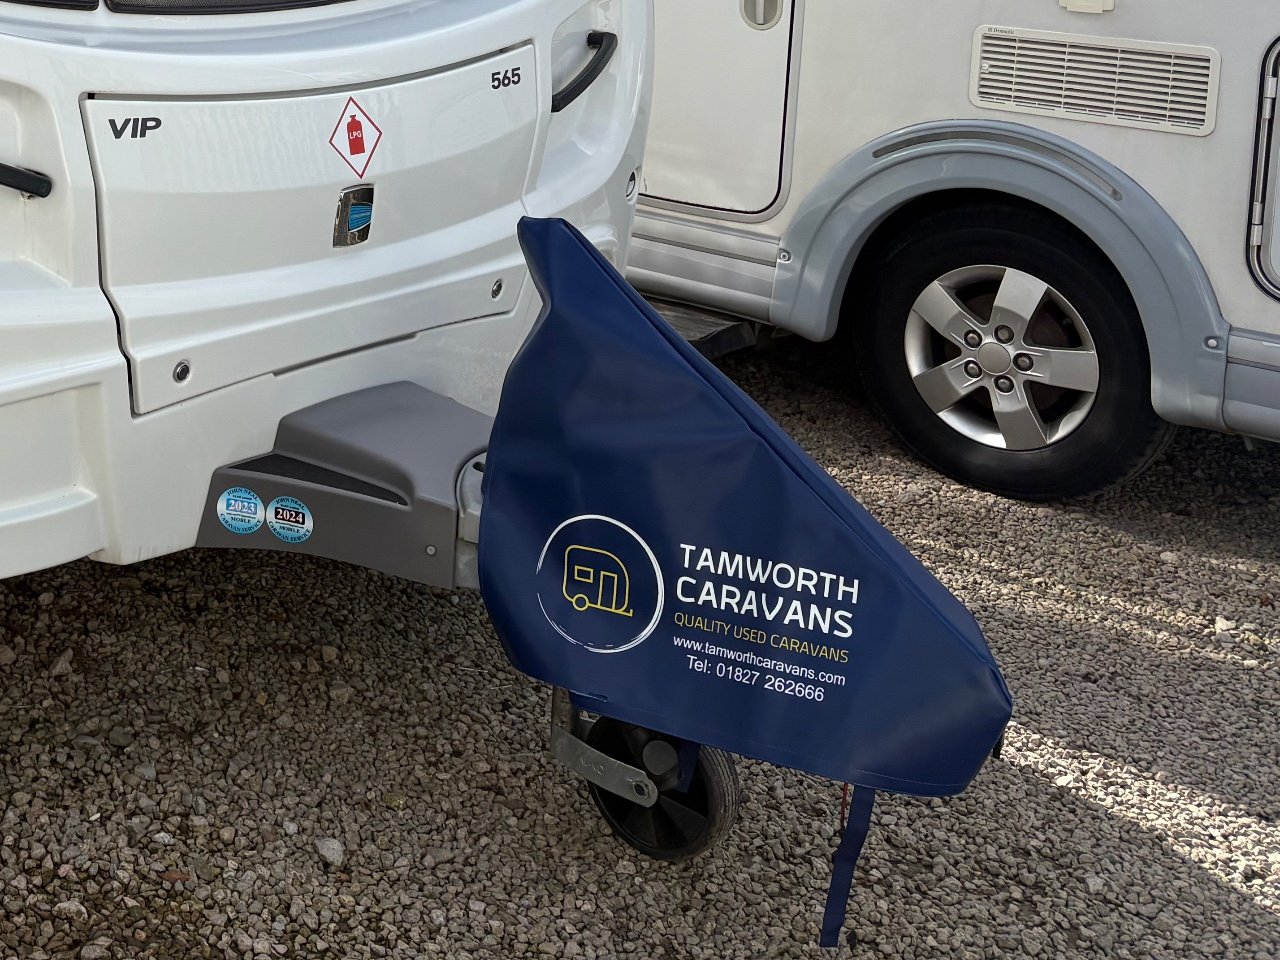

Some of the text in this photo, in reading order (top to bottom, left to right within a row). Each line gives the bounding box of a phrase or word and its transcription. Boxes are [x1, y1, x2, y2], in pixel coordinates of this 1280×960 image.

[491, 66, 522, 90] 565
[108, 117, 162, 139] VIP
[349, 130, 362, 139] LPG
[228, 500, 255, 513] 2023
[276, 509, 303, 523] 2024
[679, 543, 860, 604] TAMWORTH
[676, 576, 853, 638] CARAVANS
[674, 612, 849, 663] QUALITY USED CARAVANS
[673, 636, 846, 686] www.tamworthcaravans.com
[686, 654, 825, 702] Tel: 01827 262666
